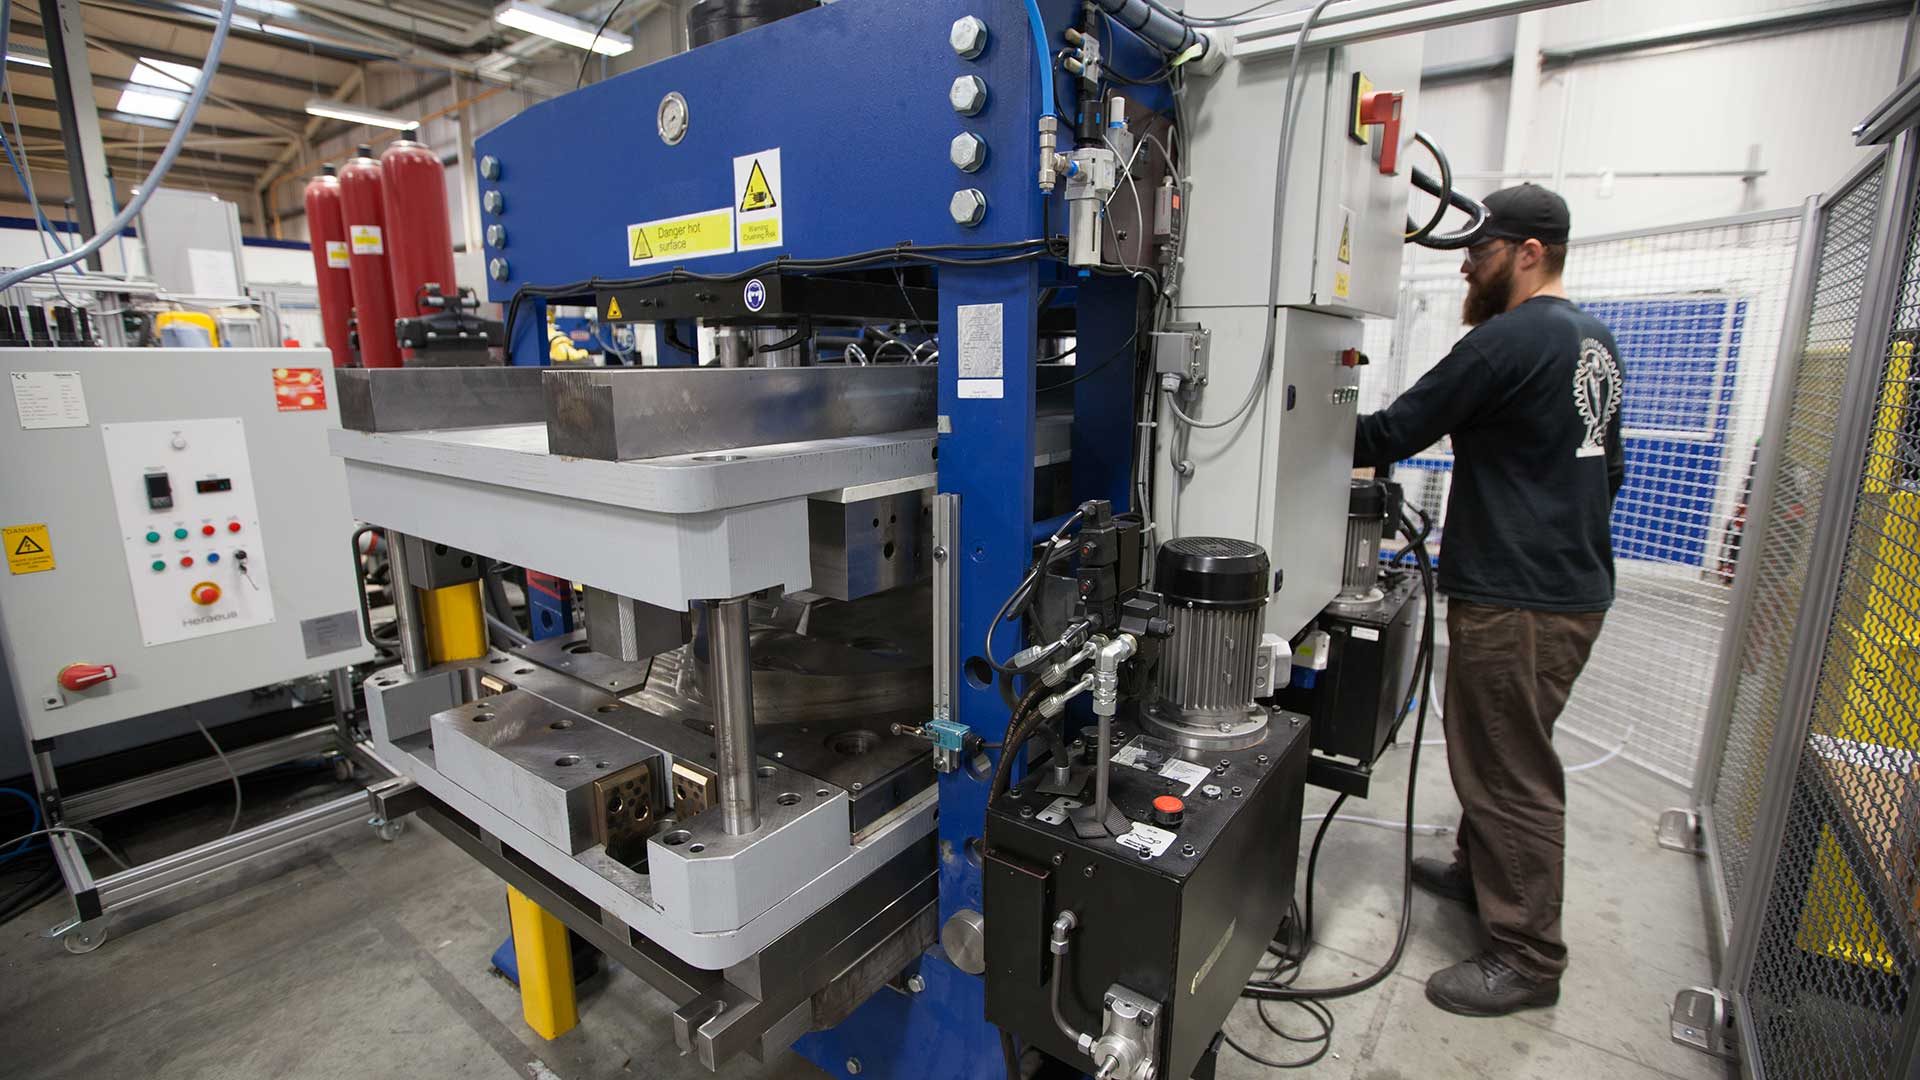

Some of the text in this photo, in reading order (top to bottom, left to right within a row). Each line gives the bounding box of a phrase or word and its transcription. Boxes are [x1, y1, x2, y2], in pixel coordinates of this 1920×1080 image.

[657, 223, 701, 239] Danger hot
[659, 240, 687, 251] surface
[182, 610, 239, 627] Heraeus
